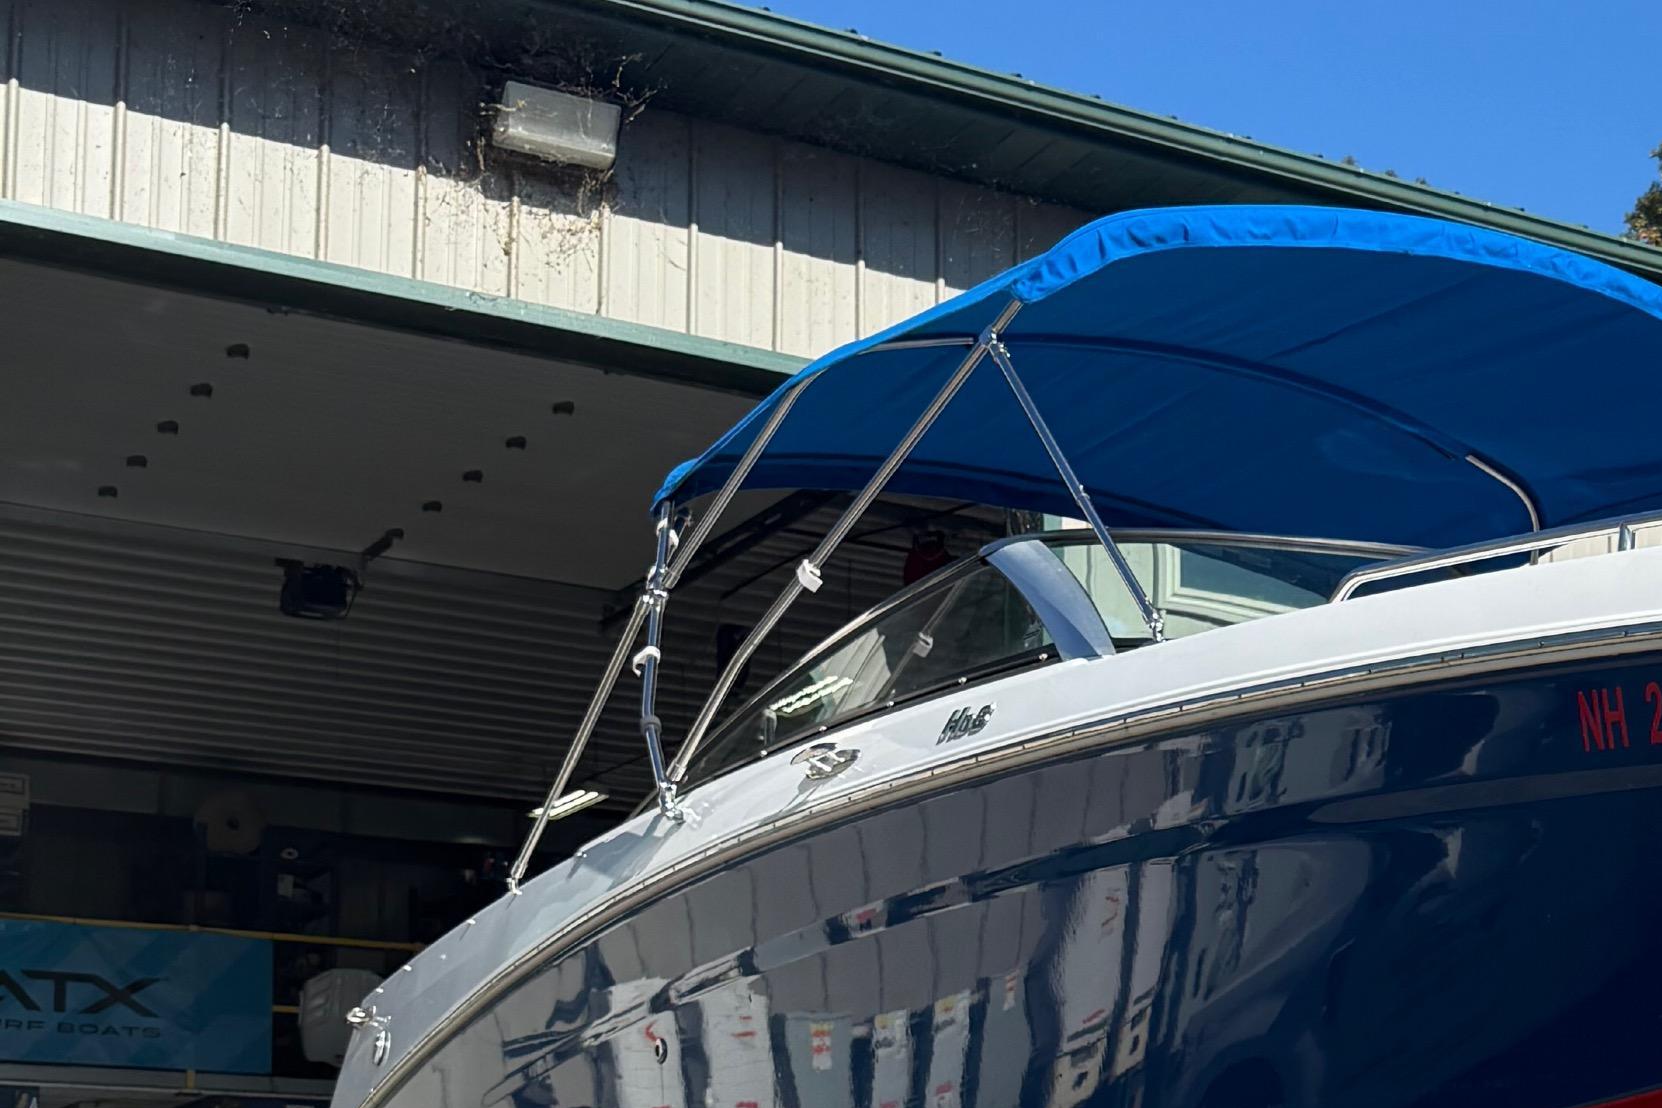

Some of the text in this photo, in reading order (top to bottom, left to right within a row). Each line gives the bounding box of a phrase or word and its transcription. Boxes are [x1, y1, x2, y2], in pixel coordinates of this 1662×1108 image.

[1577, 687, 1630, 752] NH
[0, 969, 168, 1018] ATX
[0, 1018, 161, 1039] RF BOATS
